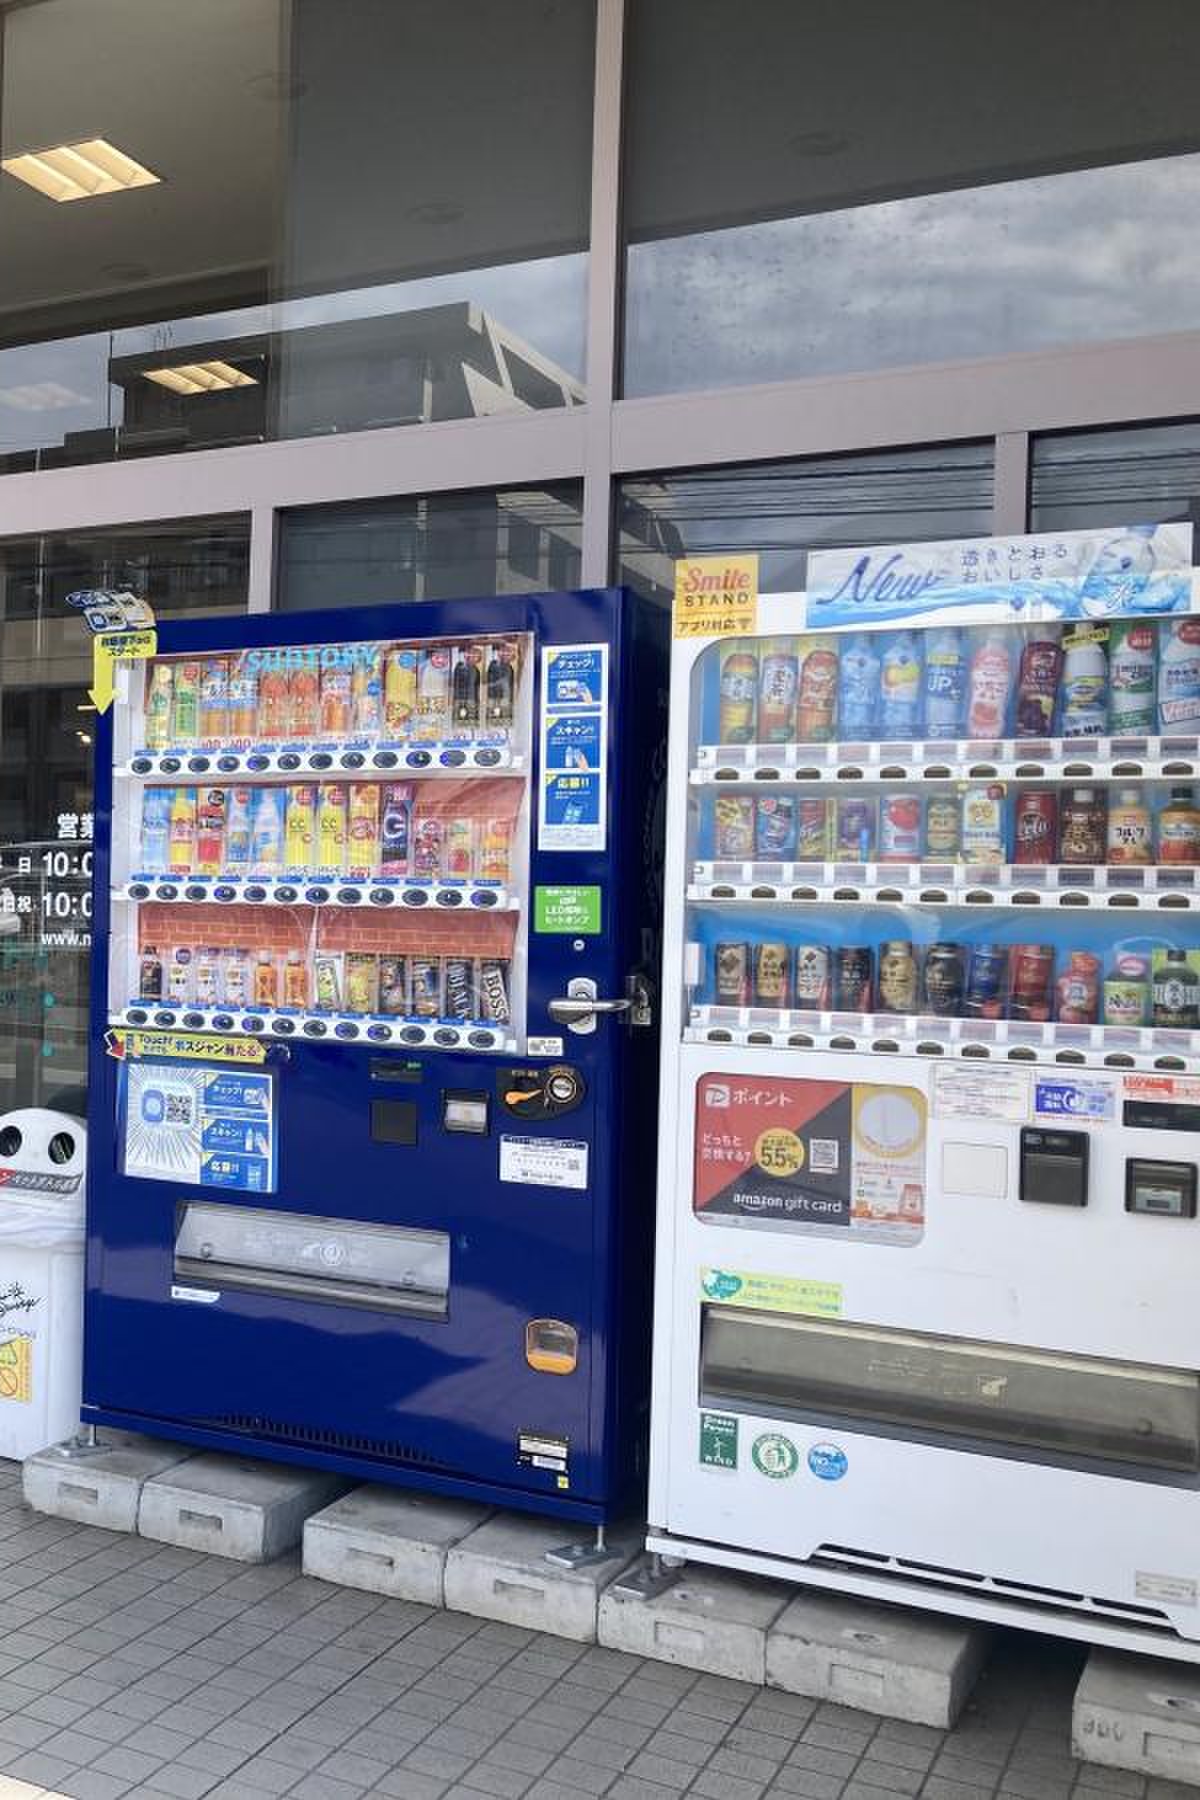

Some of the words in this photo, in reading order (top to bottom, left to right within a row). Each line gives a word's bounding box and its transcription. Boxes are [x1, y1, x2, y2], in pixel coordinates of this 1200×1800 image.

[685, 566, 751, 592] Smile
[816, 554, 944, 604] New
[685, 592, 750, 607] STAND
[733, 1089, 793, 1107] ポイント
[733, 1193, 783, 1211] amazon
[784, 1197, 809, 1212] gift
[811, 1201, 842, 1213] card
